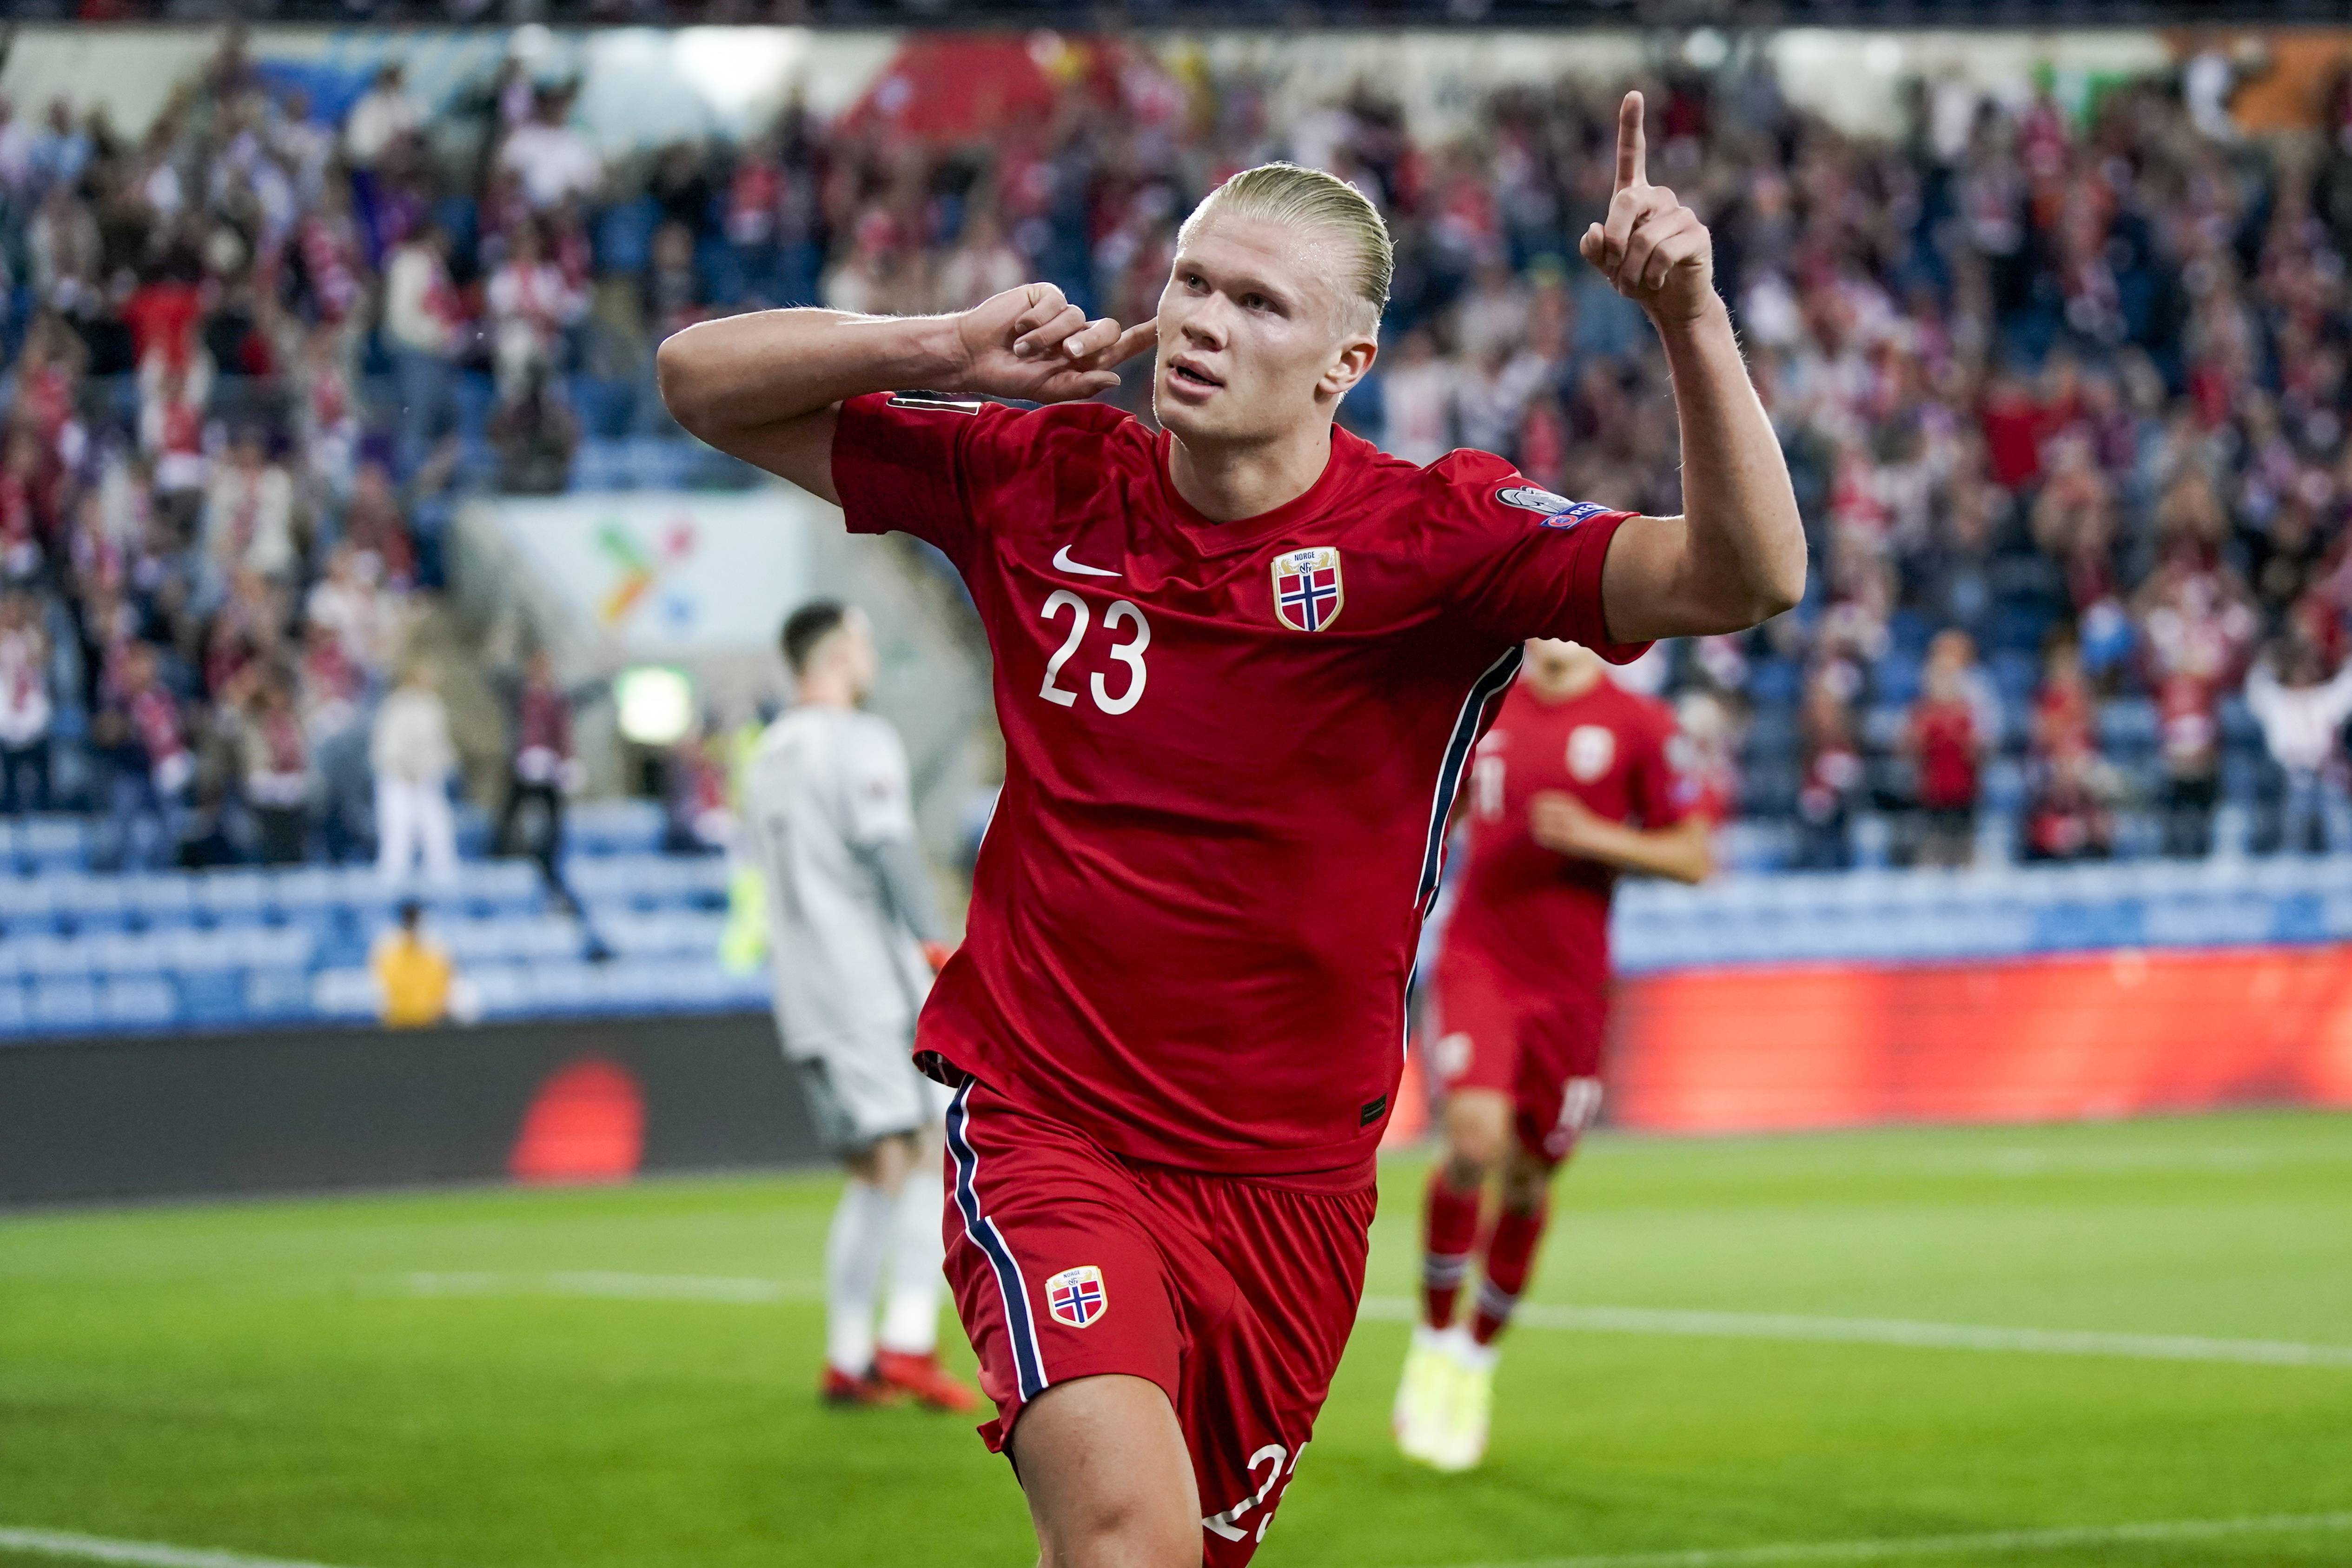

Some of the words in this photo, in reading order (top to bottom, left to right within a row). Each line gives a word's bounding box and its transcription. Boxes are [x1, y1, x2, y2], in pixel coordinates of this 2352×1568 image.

[1294, 551, 1315, 561] NORGE
[1039, 589, 1151, 715] 23
[1063, 1270, 1080, 1278] NORGE
